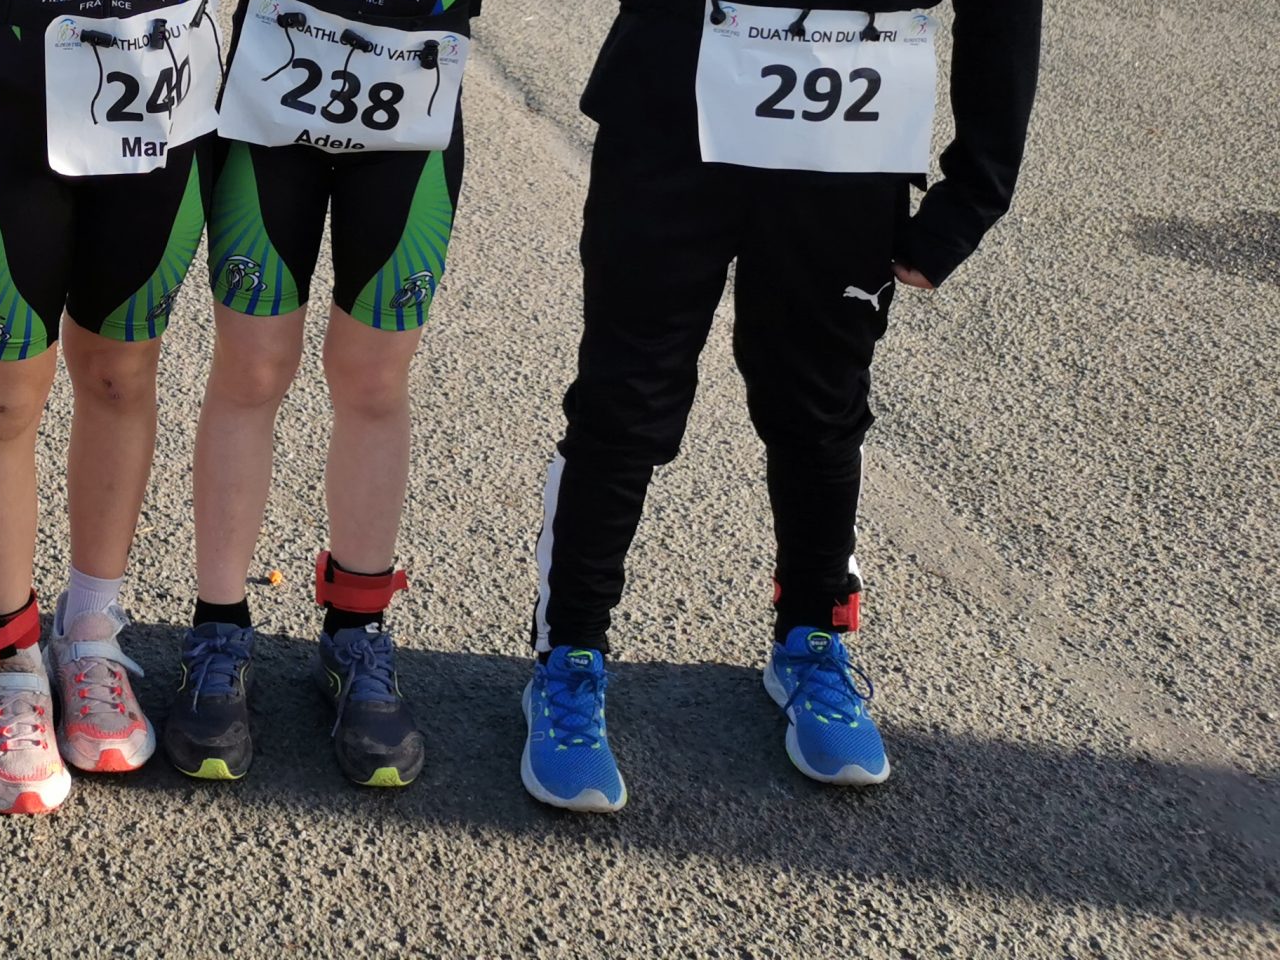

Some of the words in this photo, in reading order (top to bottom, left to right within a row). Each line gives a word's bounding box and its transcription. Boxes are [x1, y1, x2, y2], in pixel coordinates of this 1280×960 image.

[835, 31, 856, 43] DU
[388, 48, 422, 62] VATR
[280, 58, 404, 131] 238
[755, 64, 882, 122] 292
[294, 129, 366, 150] Adele
